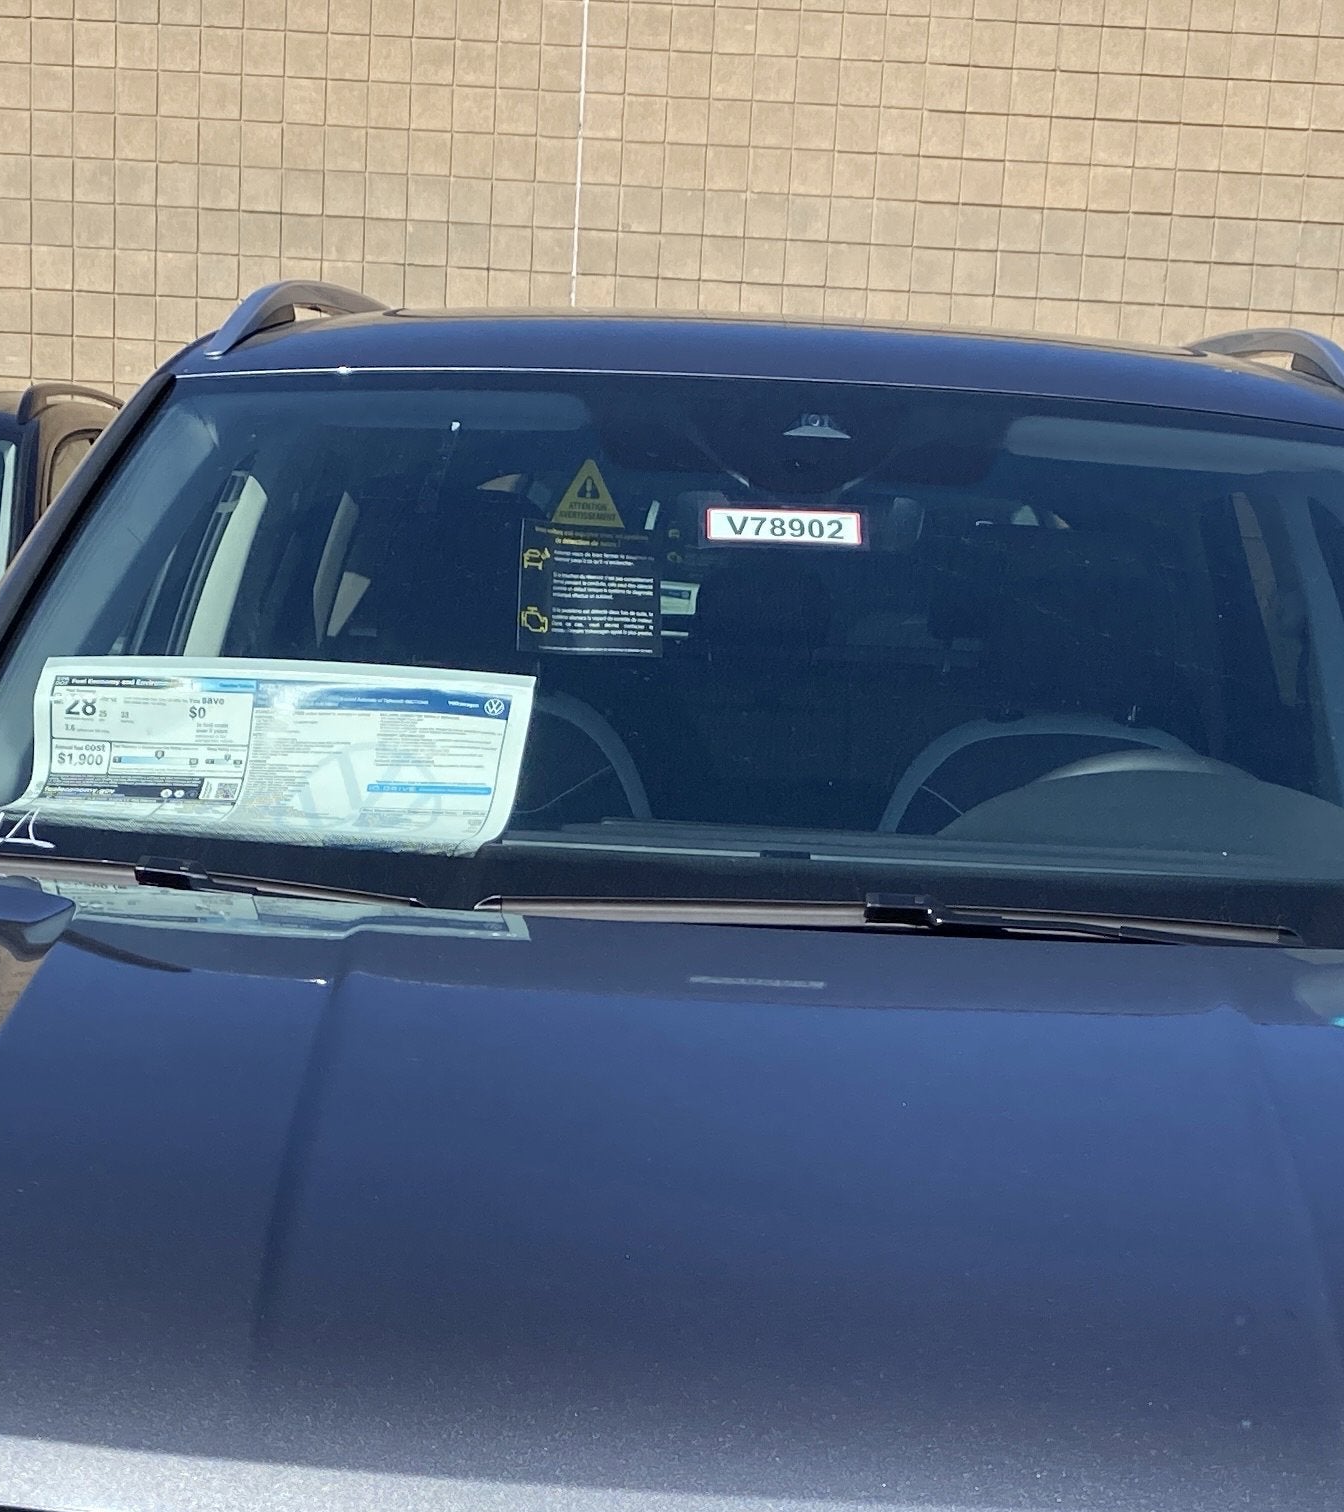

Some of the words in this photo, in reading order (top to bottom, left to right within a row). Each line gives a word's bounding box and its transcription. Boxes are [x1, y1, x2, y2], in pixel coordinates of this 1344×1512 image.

[726, 515, 844, 540] V78902
[65, 697, 97, 717] 28
[188, 704, 206, 720] $0
[85, 744, 106, 752] cost
[57, 752, 104, 767] $1,900
